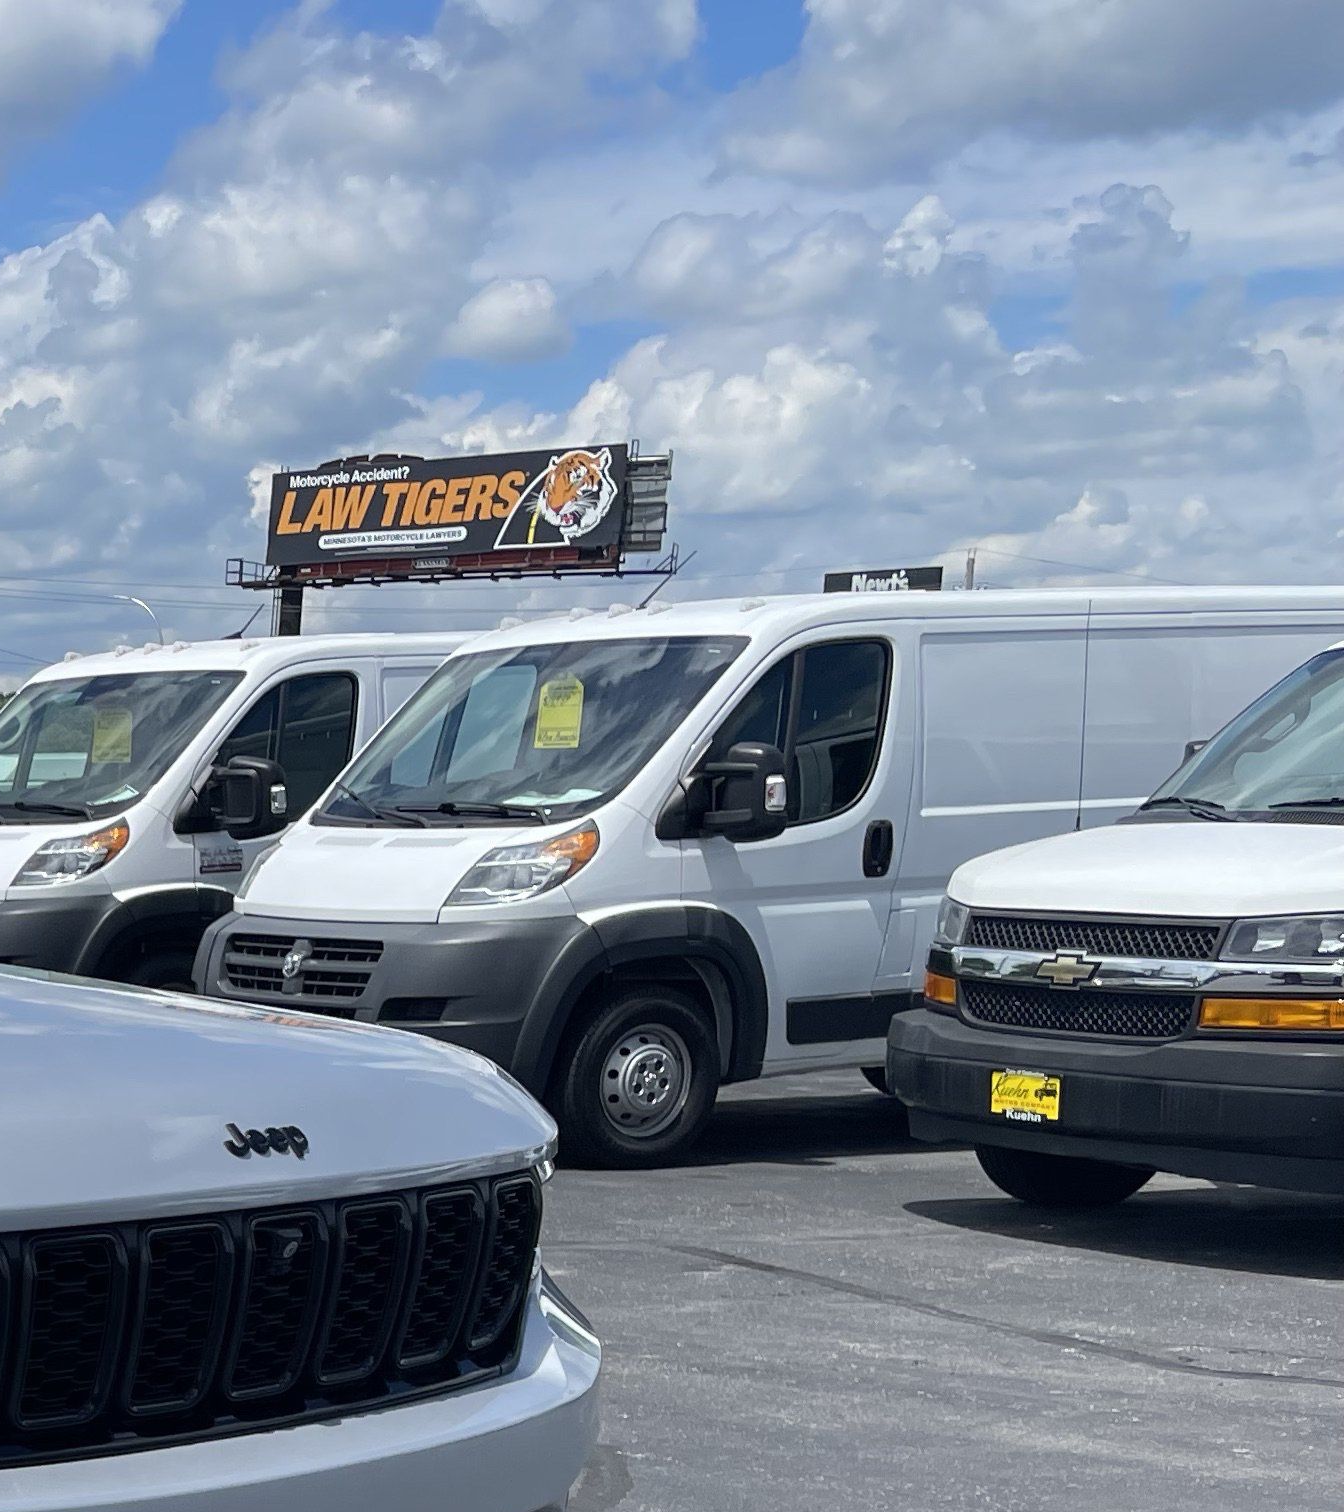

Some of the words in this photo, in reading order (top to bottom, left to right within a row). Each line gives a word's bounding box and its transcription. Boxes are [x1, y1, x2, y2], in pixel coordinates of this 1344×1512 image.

[290, 469, 350, 488] Motorcycle
[351, 466, 410, 484] Accident?
[276, 485, 376, 535] LAW
[381, 470, 526, 528] TIGERS
[323, 534, 373, 546] MINNESOTA'S
[373, 532, 425, 543] MOTORCYCLE
[425, 529, 462, 540] LAWYERS
[992, 1073, 1029, 1099] Kuehn
[1005, 1109, 1041, 1122] Kuehn
[223, 1123, 308, 1159] Jeep
